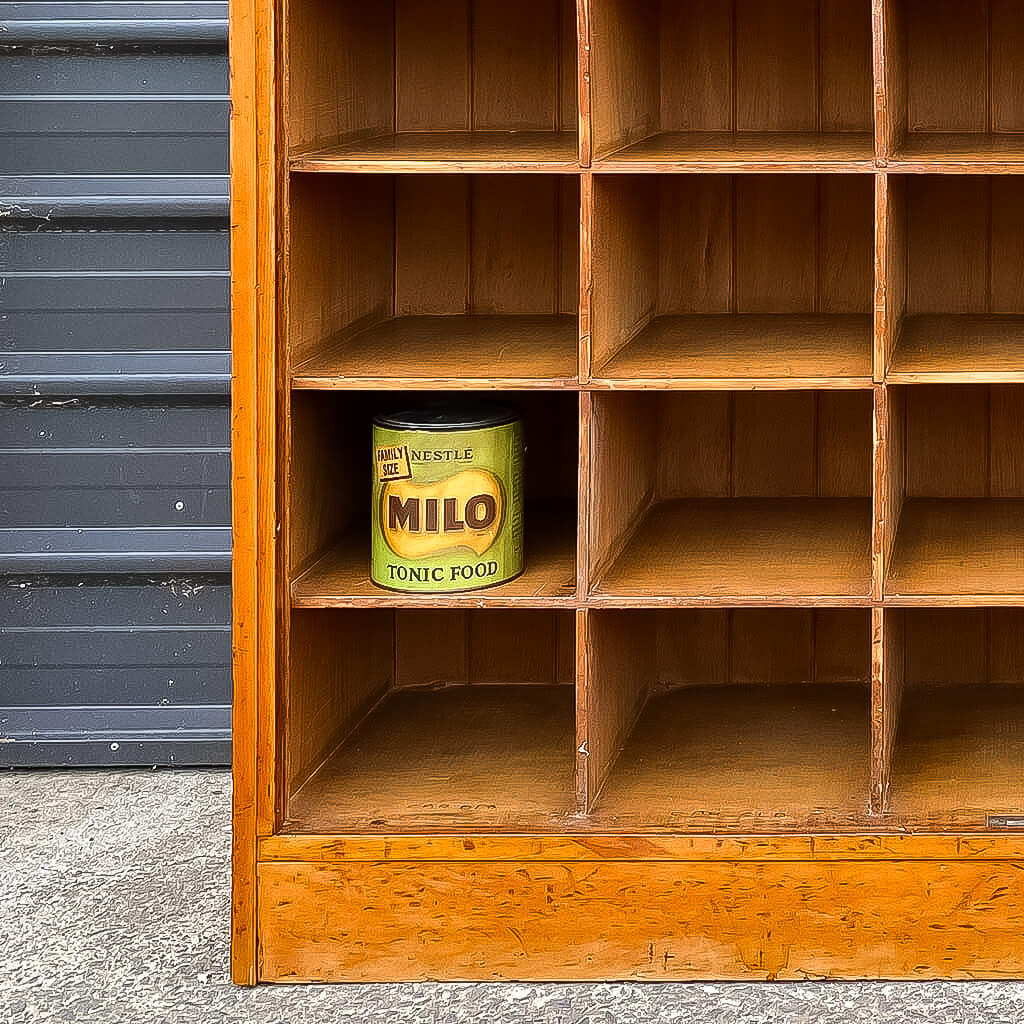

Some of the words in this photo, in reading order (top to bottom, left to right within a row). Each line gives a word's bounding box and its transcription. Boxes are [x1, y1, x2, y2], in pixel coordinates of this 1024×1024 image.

[377, 447, 403, 462] FAMILY
[382, 464, 399, 476] SIZE
[388, 494, 497, 533] MILO
[387, 564, 445, 582] TONIC
[450, 561, 498, 581] FOOD
